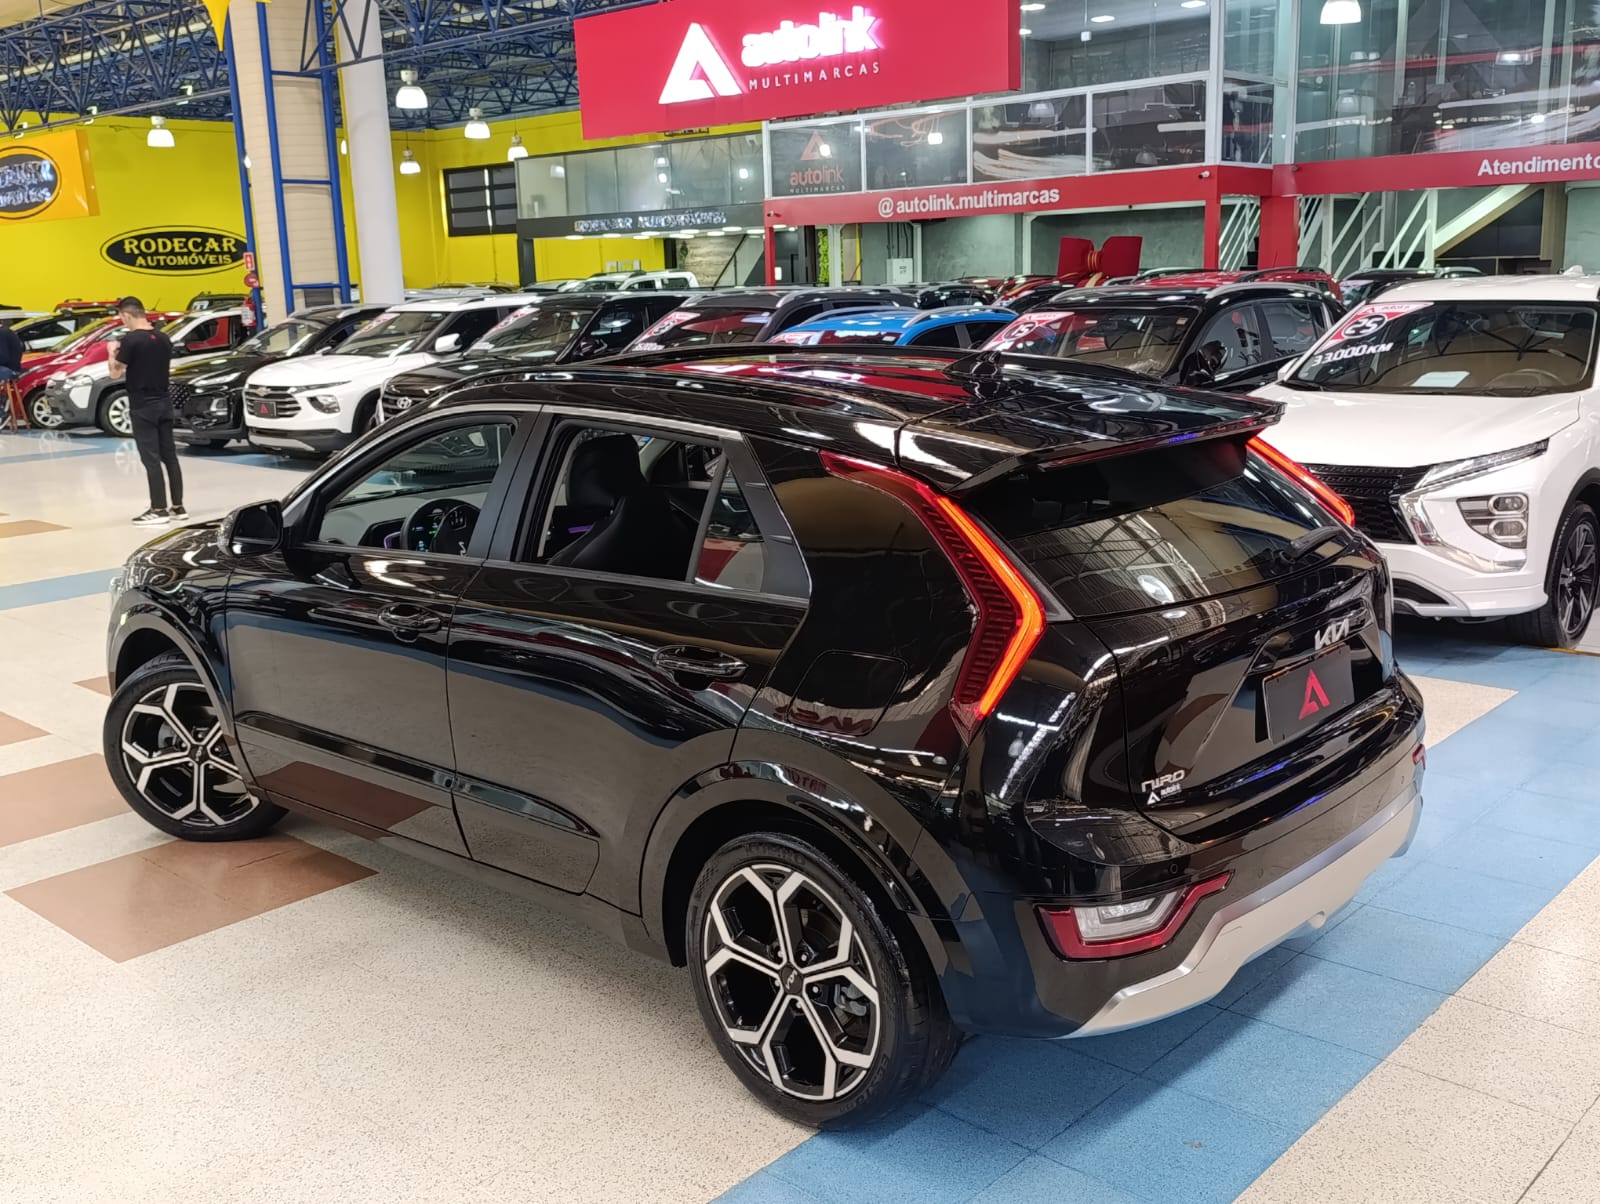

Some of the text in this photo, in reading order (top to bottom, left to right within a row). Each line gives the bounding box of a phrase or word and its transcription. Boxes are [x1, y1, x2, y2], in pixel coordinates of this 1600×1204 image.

[741, 5, 878, 67] autolink
[749, 62, 880, 90] MULTIMARCAS
[790, 163, 844, 186] autolink
[124, 238, 237, 254] RODECAR
[136, 253, 232, 266] AUTOMÓVEIS
[1344, 316, 1383, 335] 25
[1141, 769, 1185, 792] NIRO
